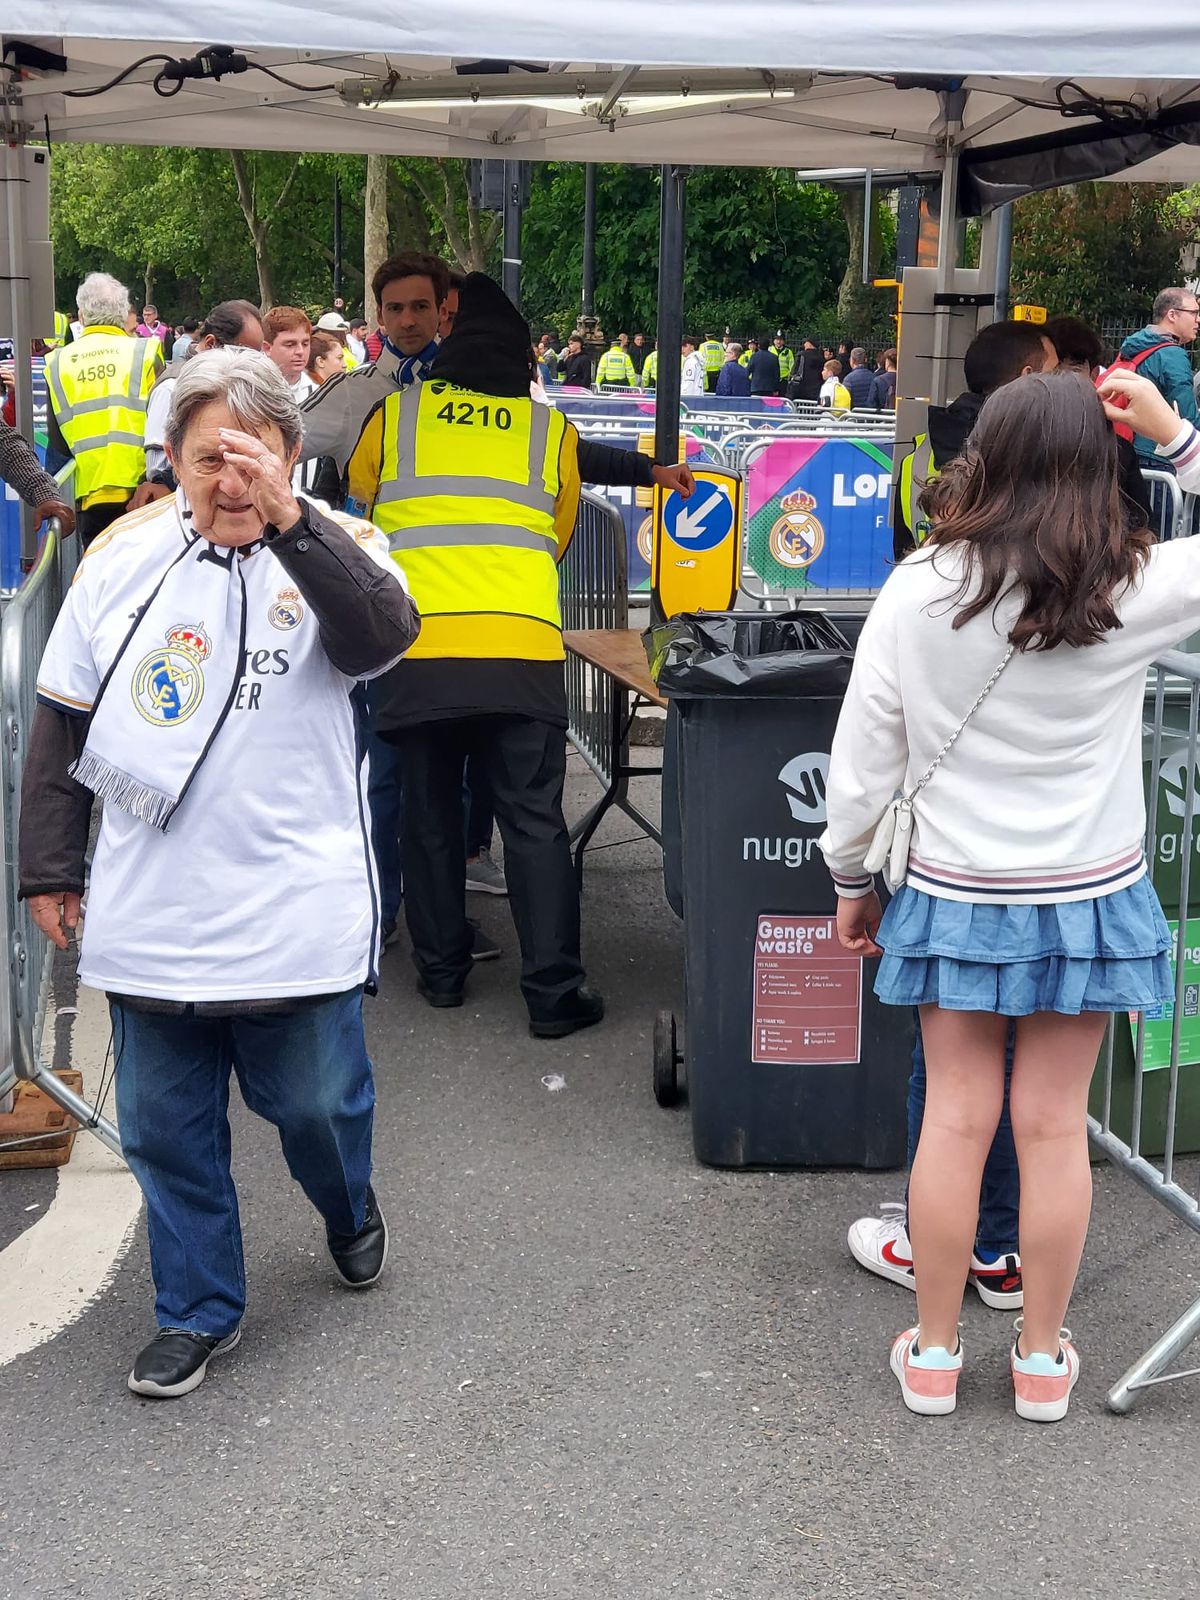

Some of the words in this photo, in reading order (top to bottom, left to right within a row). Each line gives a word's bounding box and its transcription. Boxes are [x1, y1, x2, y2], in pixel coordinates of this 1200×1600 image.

[80, 348, 120, 359] SHOWSEC
[77, 363, 116, 383] 4589
[436, 401, 512, 430] 4210
[235, 683, 262, 710] ER
[743, 837, 820, 868] nugr
[758, 921, 832, 939] General
[758, 939, 814, 954] waste
